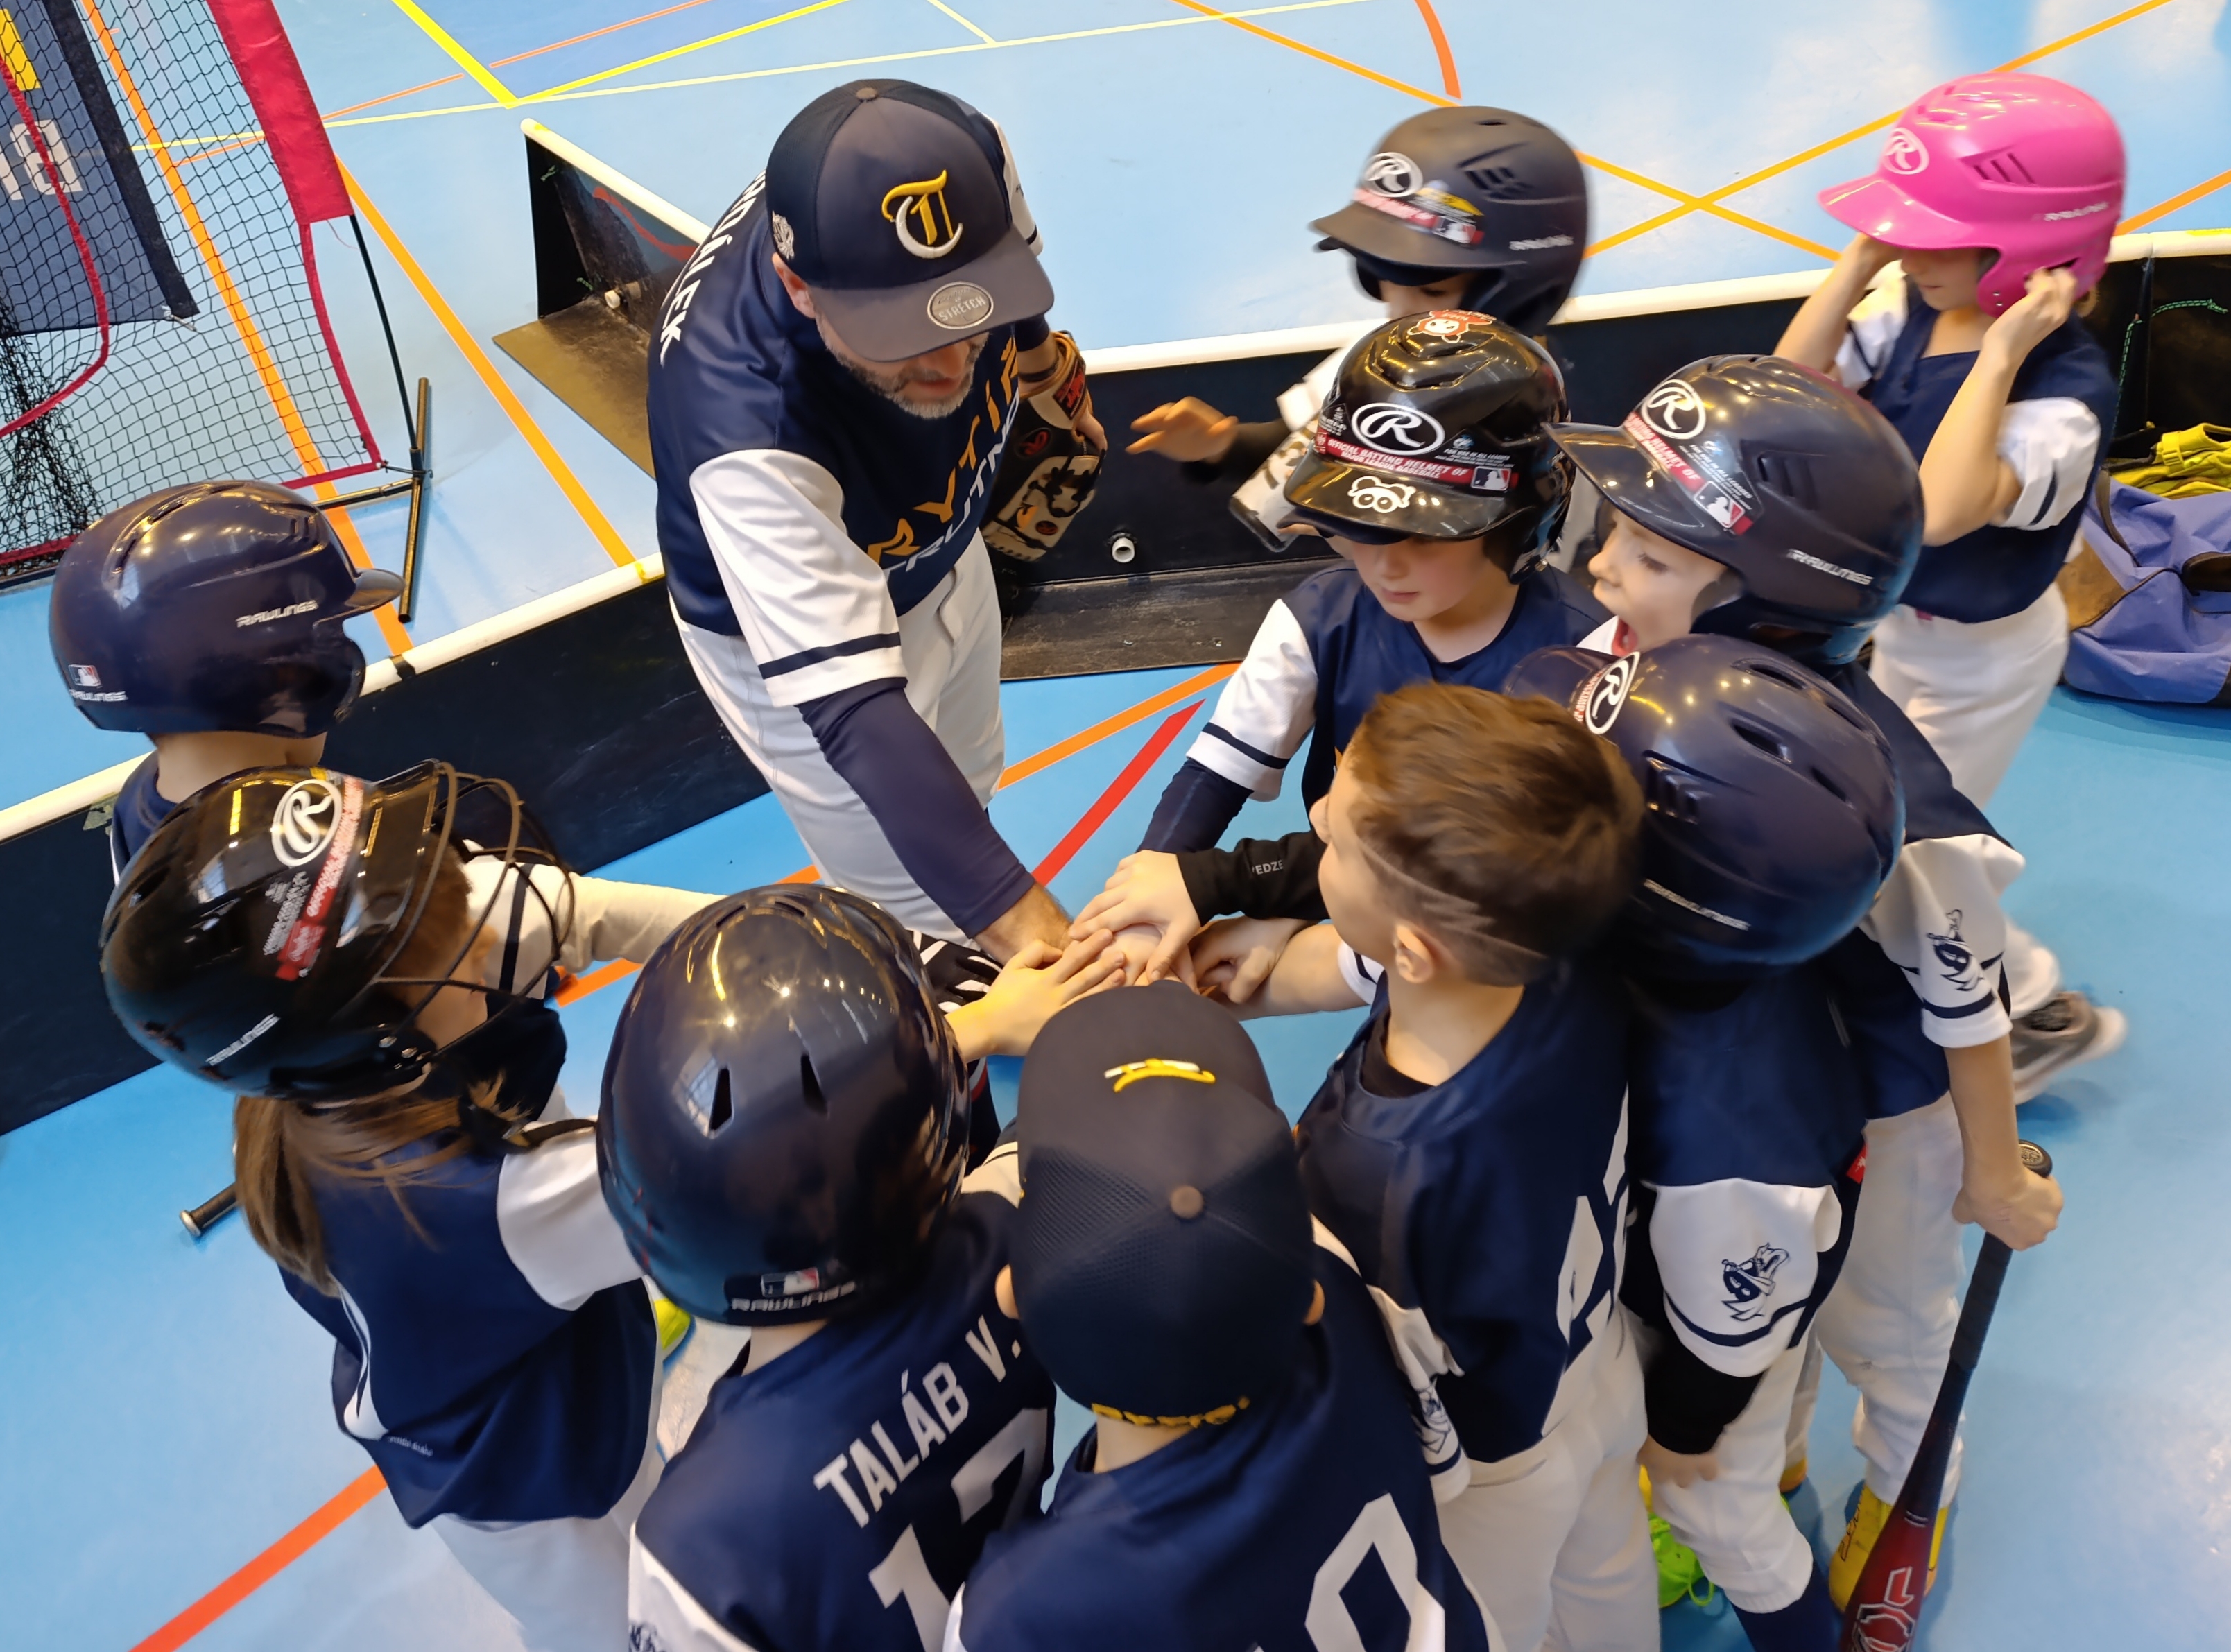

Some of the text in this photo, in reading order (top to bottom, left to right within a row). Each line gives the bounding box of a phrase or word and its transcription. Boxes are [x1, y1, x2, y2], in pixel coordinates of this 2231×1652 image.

[938, 296, 986, 322] STRETCH
[1327, 438, 1359, 455] OFFICIAL
[1359, 449, 1404, 466] BATTING
[1403, 458, 1453, 474] HELMET
[1451, 467, 1470, 476] OF
[1395, 465, 1440, 479] BASEBALL
[1649, 438, 1688, 467] HELMET
[1681, 468, 1702, 480] OF
[235, 599, 319, 628] RAWLINGS
[732, 1282, 856, 1312] RAWLINGS
[813, 1314, 1022, 1529] TALÁB V.
